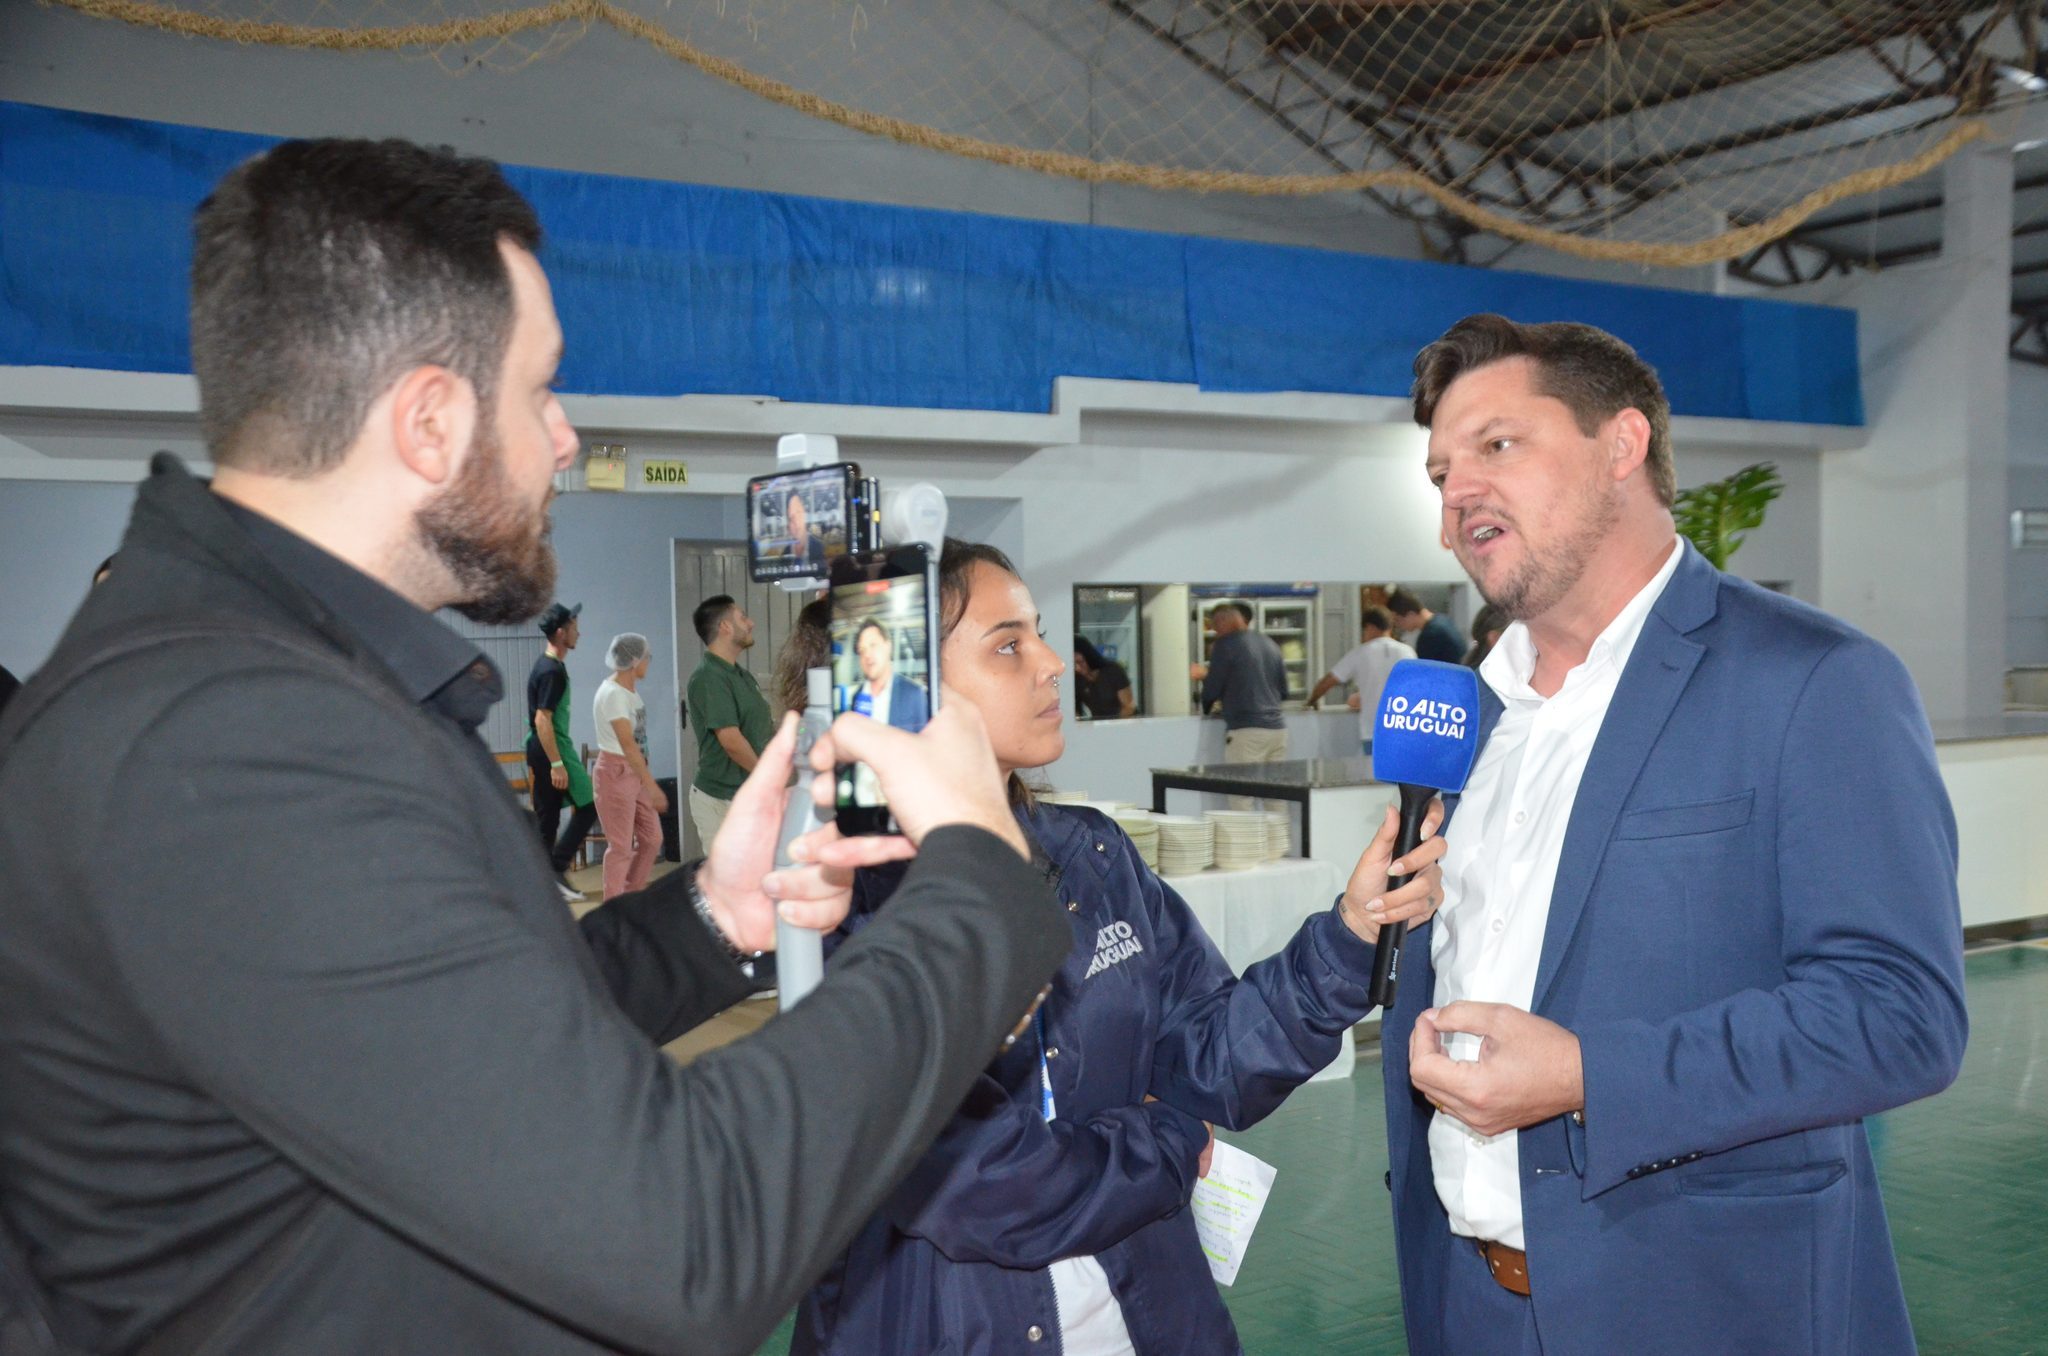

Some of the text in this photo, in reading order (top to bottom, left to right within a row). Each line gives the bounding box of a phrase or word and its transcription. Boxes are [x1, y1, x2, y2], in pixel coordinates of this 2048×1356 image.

[645, 461, 686, 482] SAÍDA
[1410, 699, 1467, 723] ALTO
[1383, 713, 1465, 740] URUGUAI
